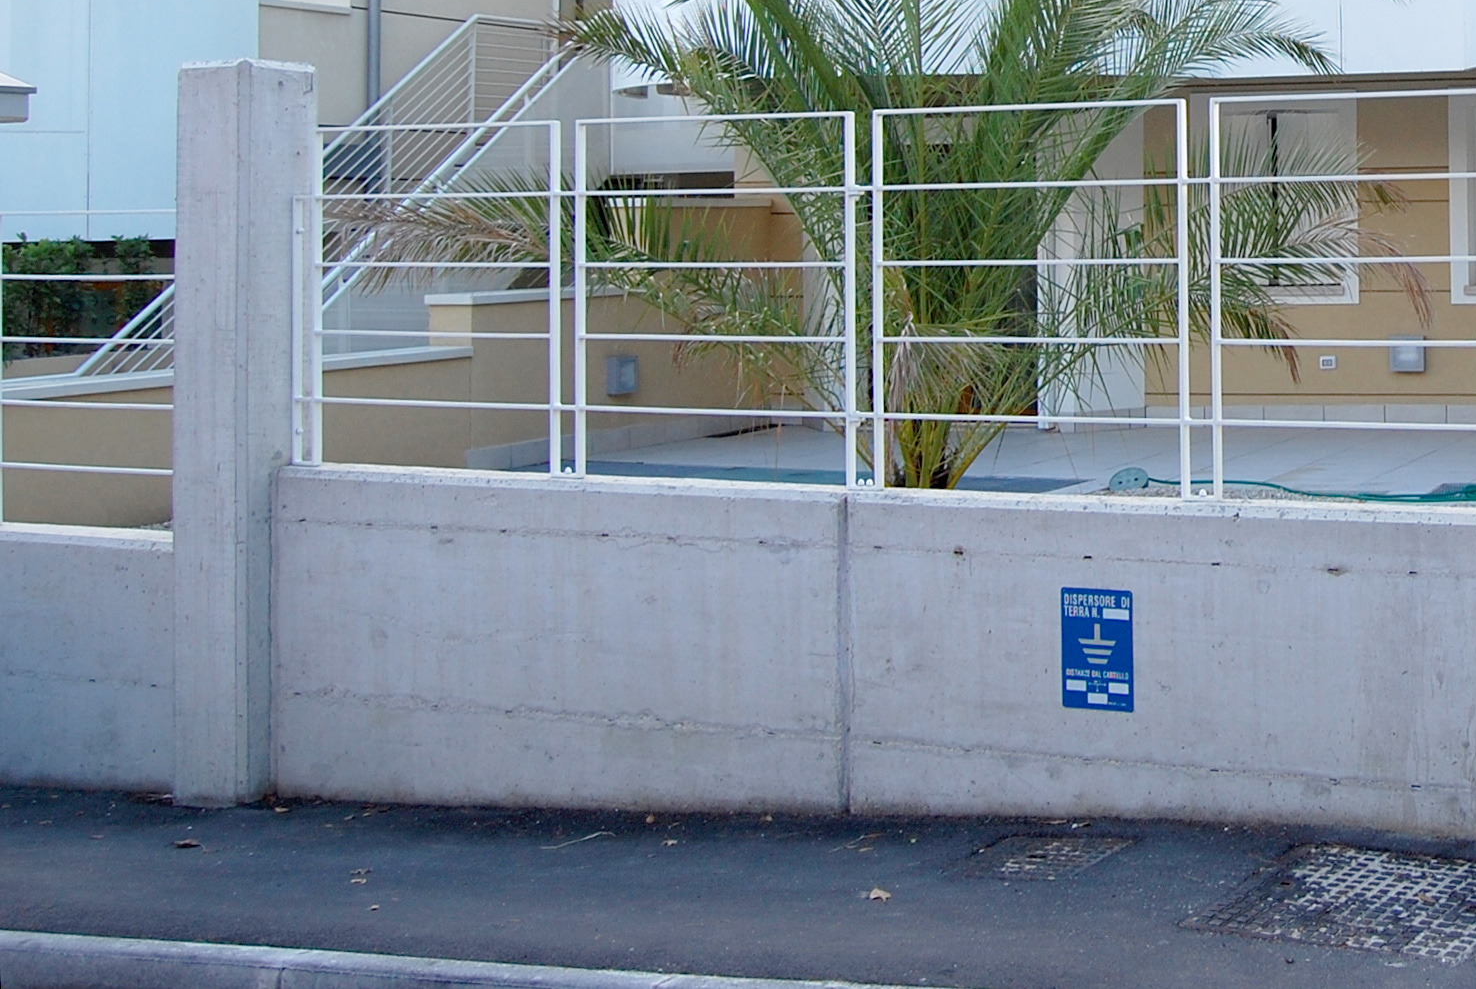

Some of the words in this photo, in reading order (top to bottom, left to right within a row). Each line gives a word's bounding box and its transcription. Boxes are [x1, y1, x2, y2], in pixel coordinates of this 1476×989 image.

[1063, 593, 1116, 608] DISPERSORE
[1121, 596, 1130, 608] DI
[1064, 605, 1090, 618] TERRA
[1091, 606, 1100, 618] N.
